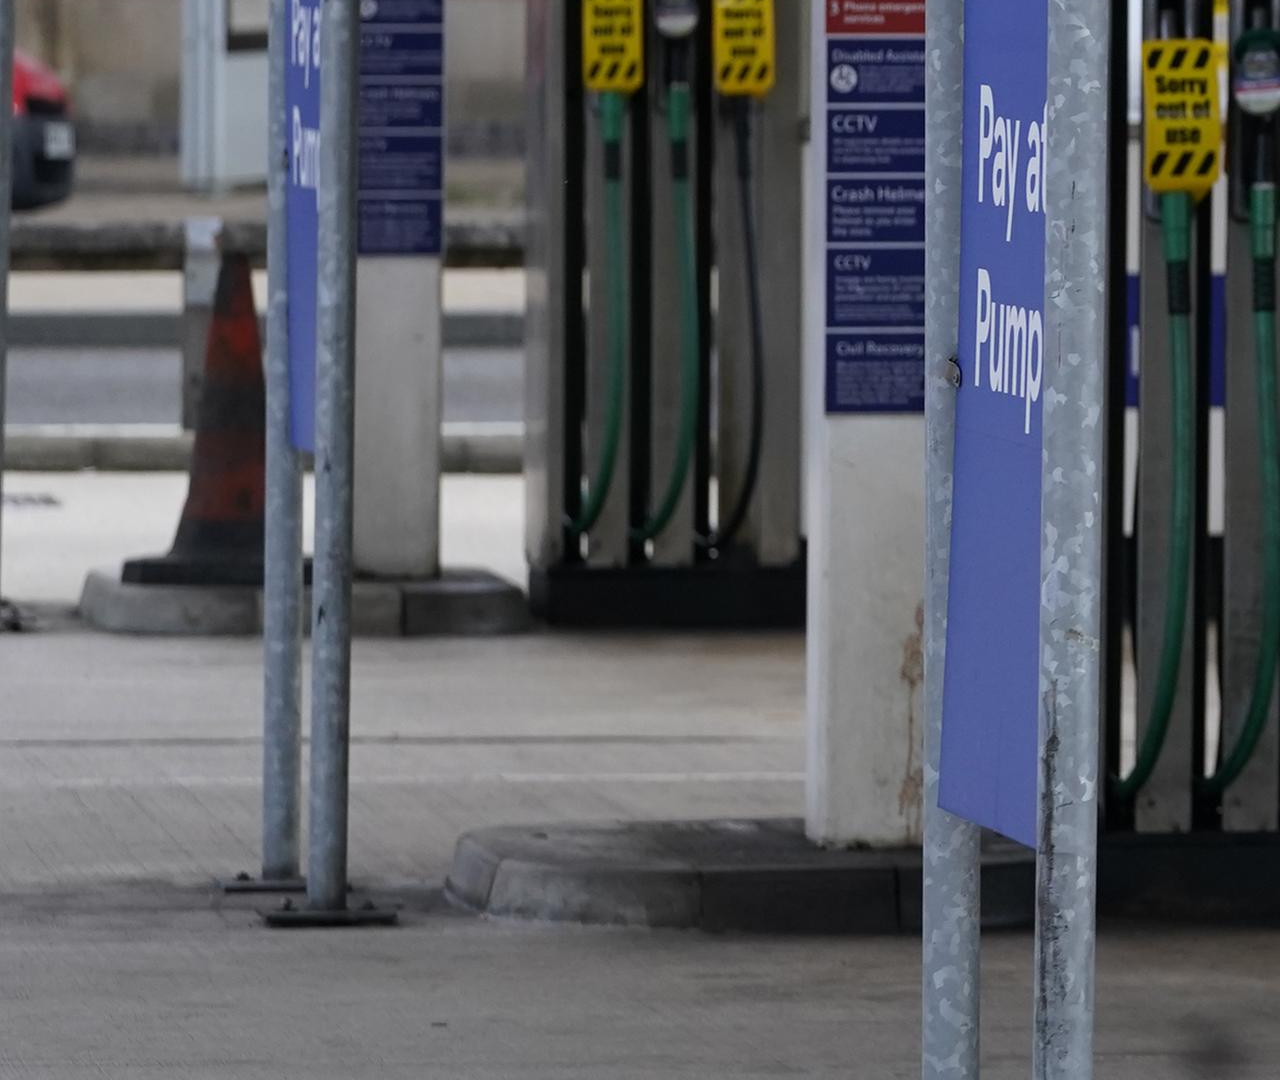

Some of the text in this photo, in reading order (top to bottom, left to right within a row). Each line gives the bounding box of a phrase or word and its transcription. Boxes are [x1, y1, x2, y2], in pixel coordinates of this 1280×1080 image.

[1155, 75, 1208, 95] Sorry
[1156, 99, 1210, 119] out of
[1166, 126, 1201, 145] use
[978, 84, 1021, 242] Pay
[974, 268, 1044, 437] Pump
